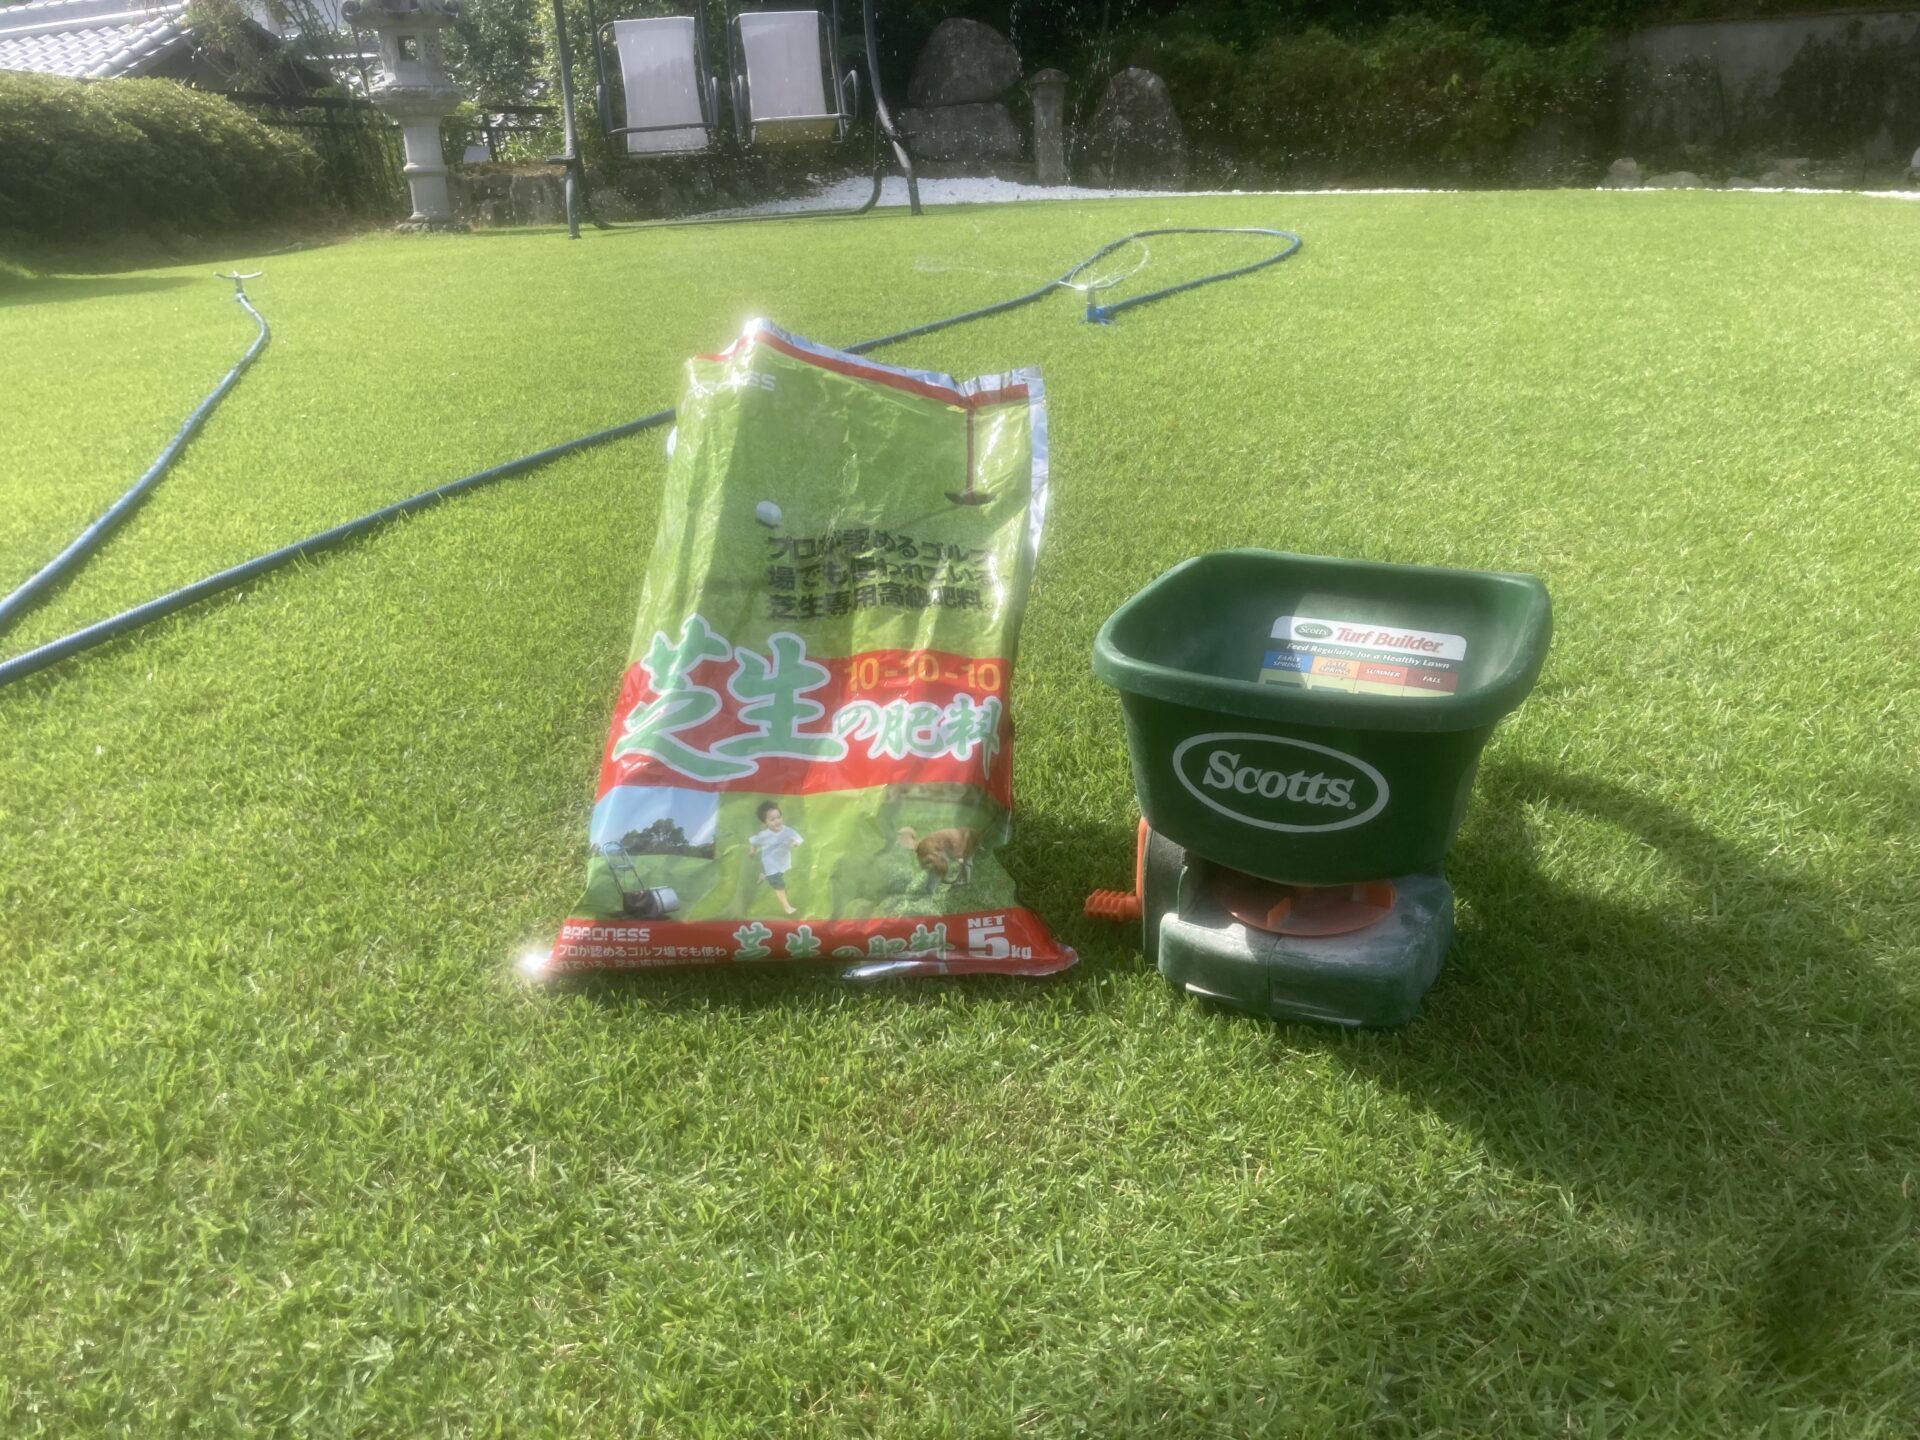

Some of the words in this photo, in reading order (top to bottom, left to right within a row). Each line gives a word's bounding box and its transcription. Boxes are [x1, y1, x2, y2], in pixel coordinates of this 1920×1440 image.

[1299, 625, 1330, 636] Scotts
[1336, 627, 1375, 644] Turf
[1373, 632, 1444, 653] Builder
[1286, 641, 1310, 652] Feed
[1310, 645, 1354, 658] Regularly
[1356, 650, 1371, 660] for
[1382, 654, 1420, 667] Healthy
[1422, 659, 1451, 670] Lawn
[1365, 667, 1401, 679] SUMMER
[1422, 675, 1442, 684] FALL
[611, 612, 1002, 784] 芝生の肥料
[967, 914, 1006, 929] NET
[562, 926, 650, 942] BARONESS
[559, 945, 727, 959] プロが認めるゴルフ場でも使わ
